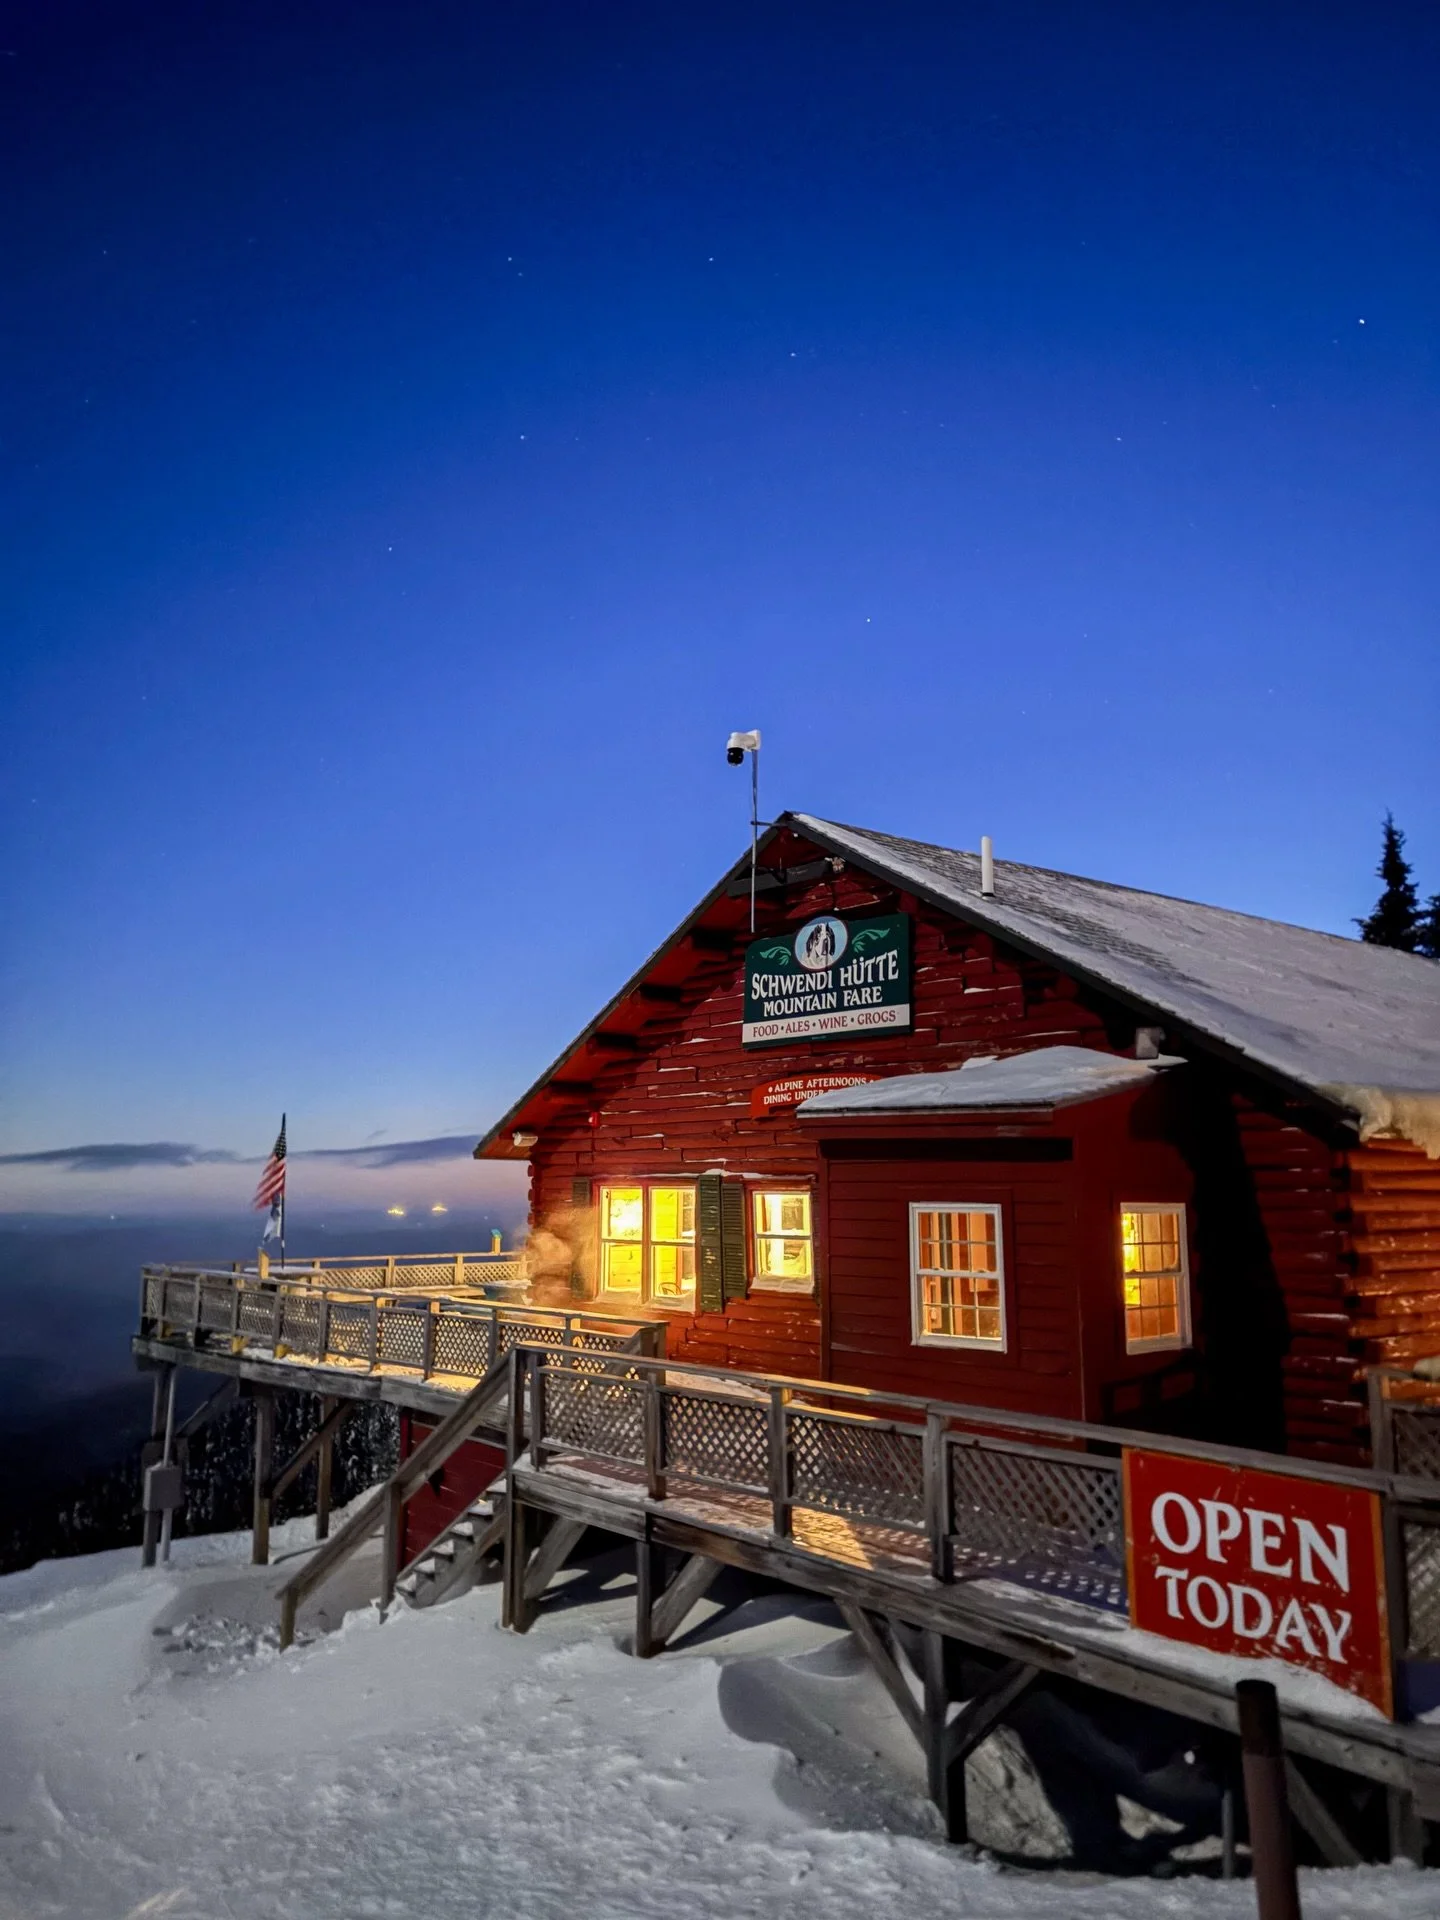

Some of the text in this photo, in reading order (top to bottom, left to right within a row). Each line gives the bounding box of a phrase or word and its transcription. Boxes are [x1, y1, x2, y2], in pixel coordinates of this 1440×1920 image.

[751, 949, 899, 1000] SCHWENDI HÜTTE
[763, 986, 883, 1017] MOUNTAIN FARE
[752, 1009, 896, 1038] FOOD ALES WINE GROGS
[763, 1092, 792, 1105] DINING
[774, 1076, 867, 1093] ALPINE AFTERNOONS
[1151, 1491, 1350, 1593] OPEN
[1154, 1565, 1352, 1665] TODAY
